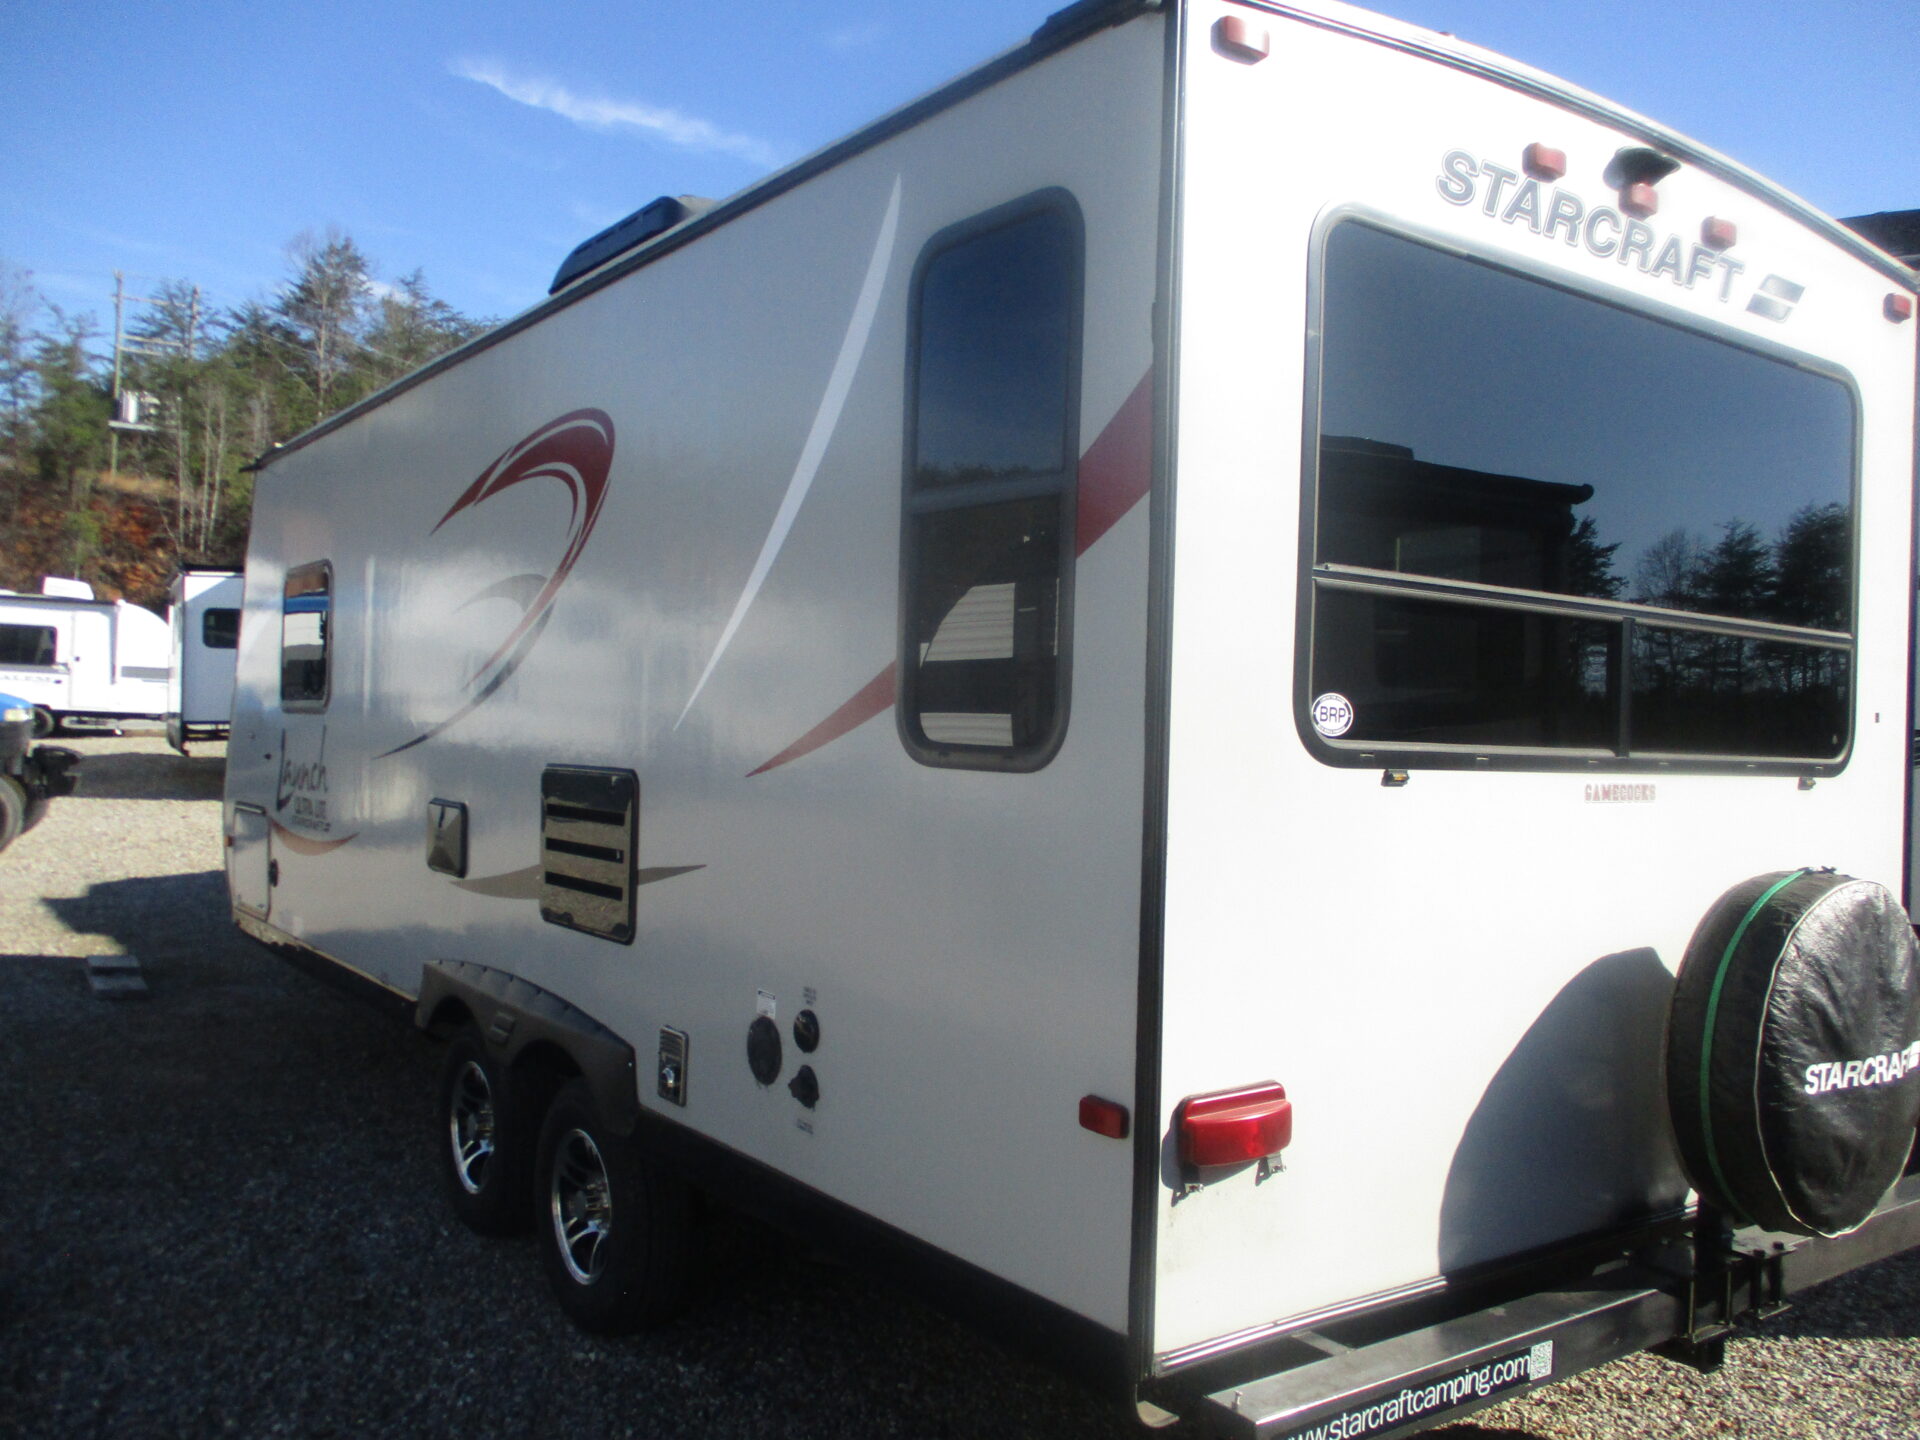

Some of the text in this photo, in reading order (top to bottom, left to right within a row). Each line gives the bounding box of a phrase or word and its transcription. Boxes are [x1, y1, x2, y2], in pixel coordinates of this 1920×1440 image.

[1436, 148, 1744, 303] STARCRAFT
[1319, 705, 1347, 723] BRP
[1584, 783, 1657, 803] GAMECOCKS
